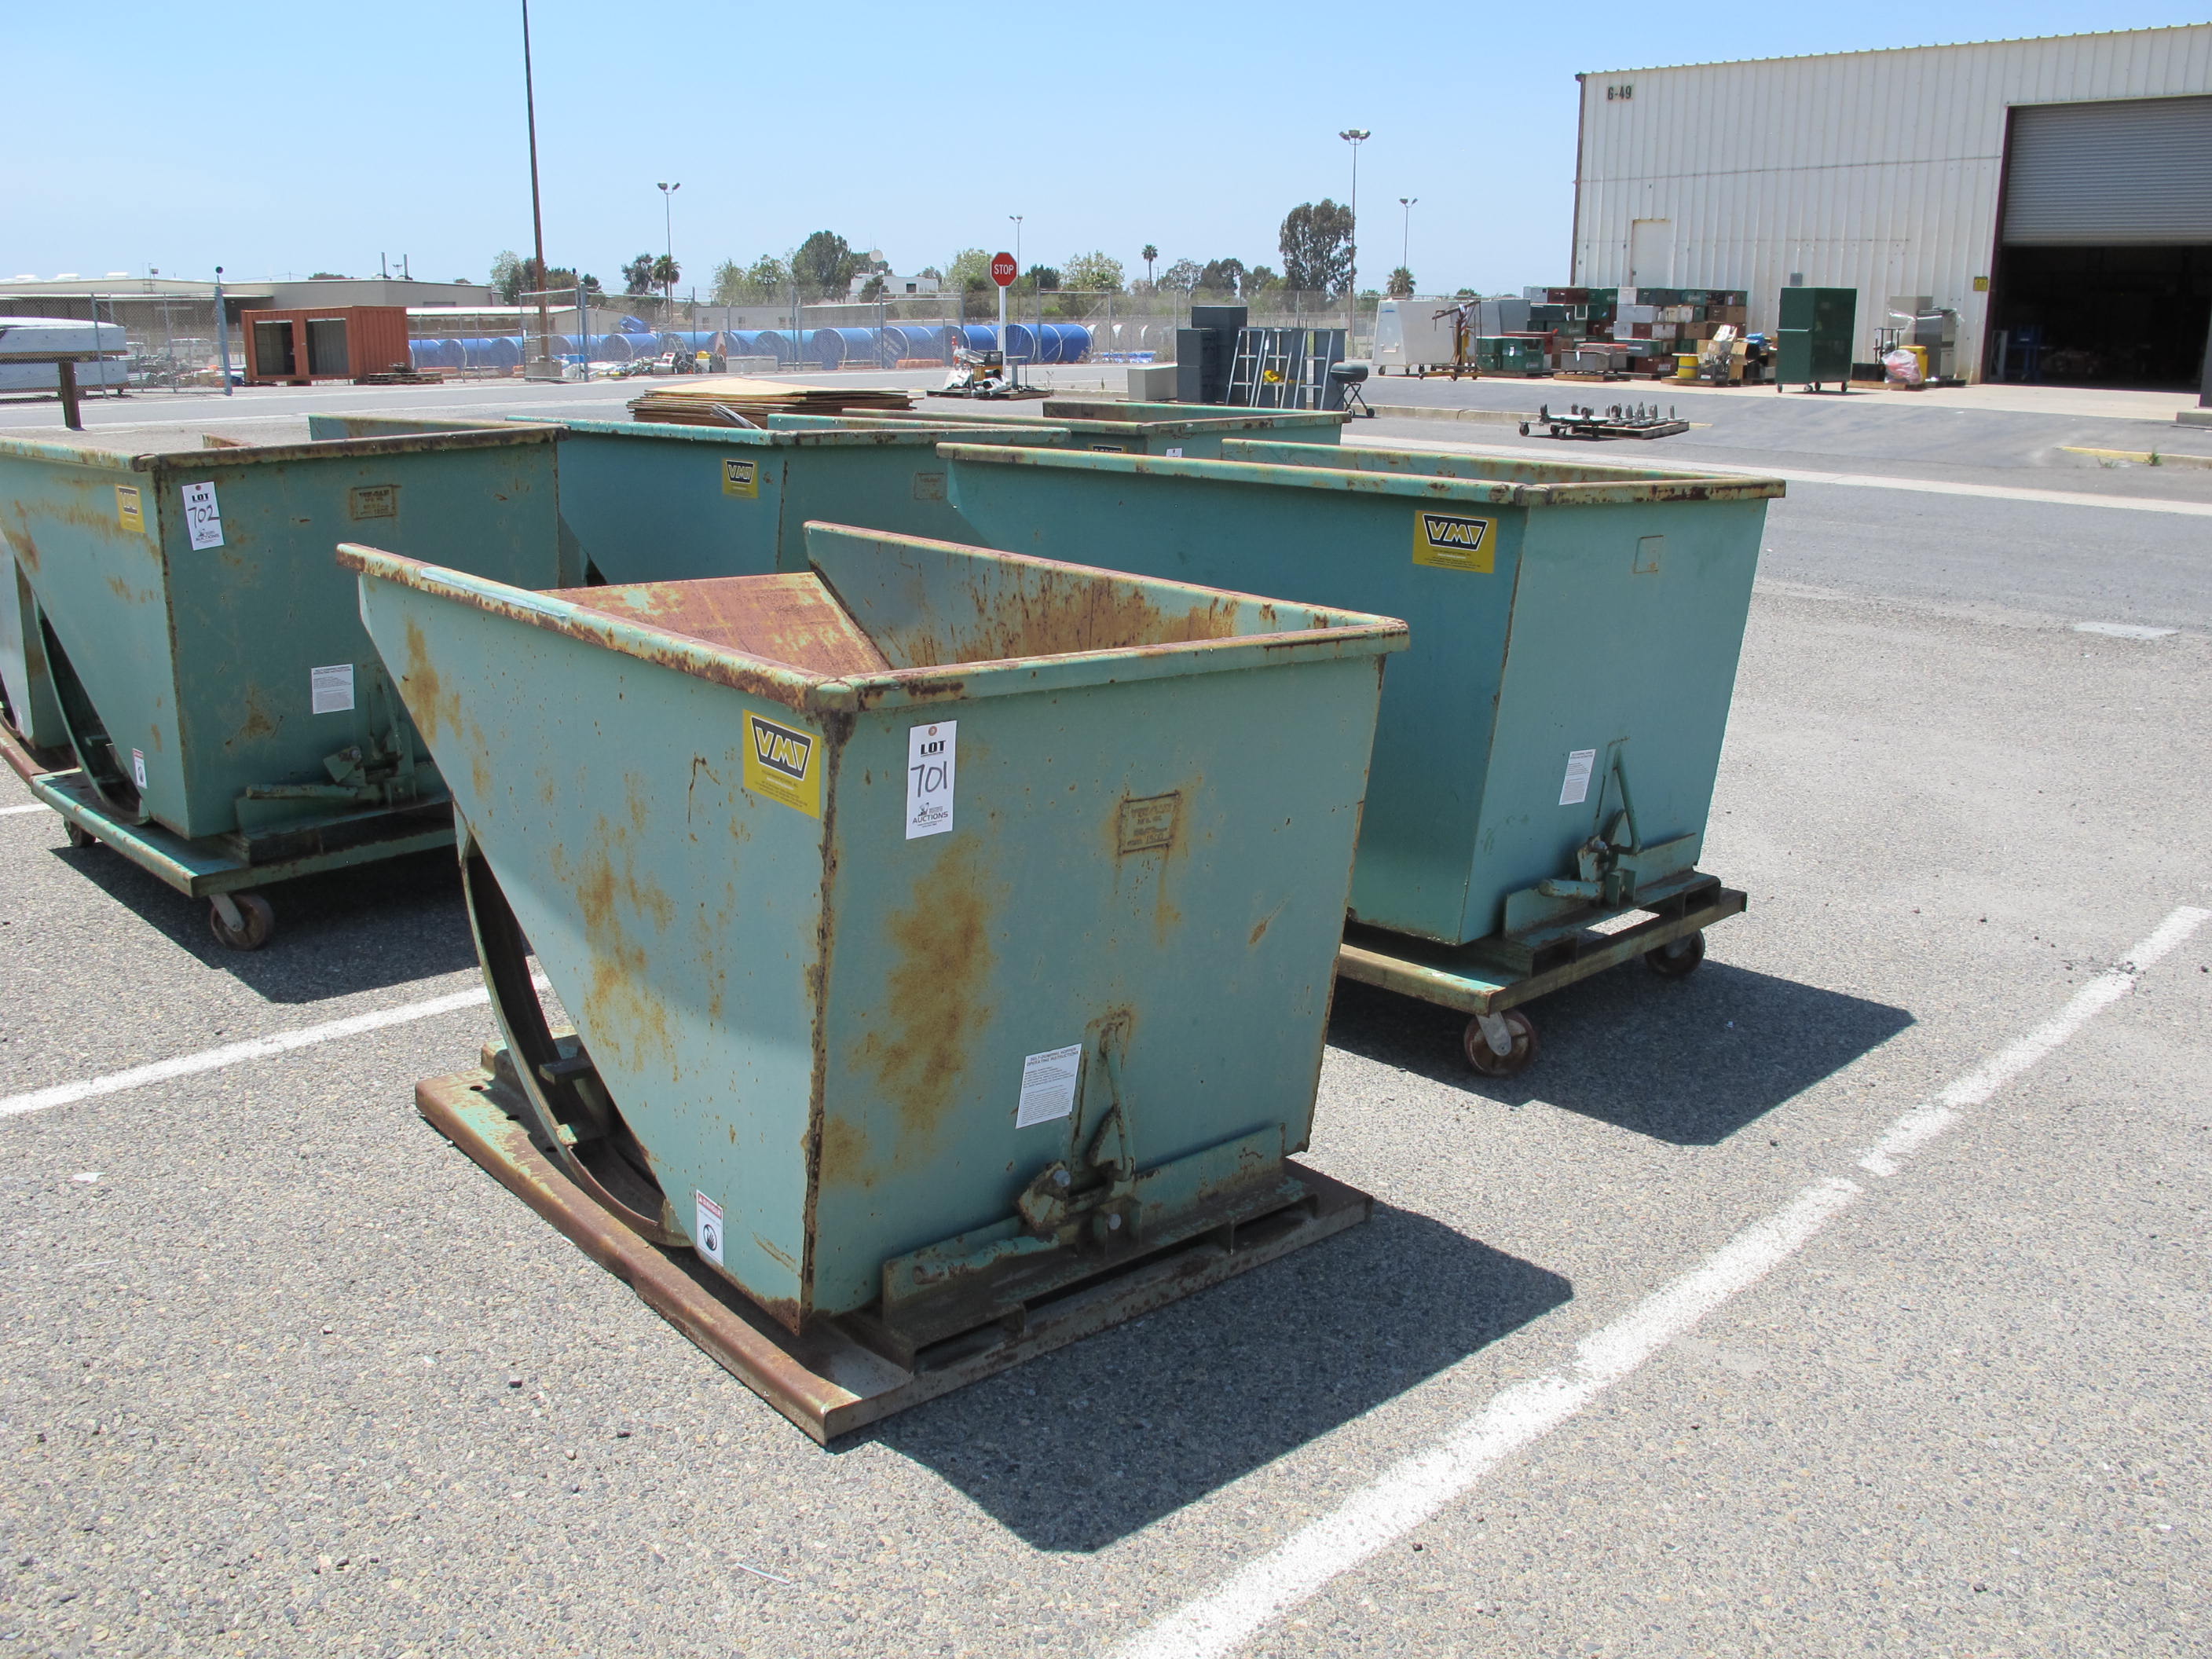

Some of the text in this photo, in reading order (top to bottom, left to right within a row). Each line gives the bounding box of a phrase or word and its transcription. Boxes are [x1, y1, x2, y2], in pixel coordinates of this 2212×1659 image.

[994, 264, 1014, 275] STOP
[191, 493, 209, 502] LOT
[188, 504, 221, 528] 702
[920, 740, 947, 756] LOT
[910, 760, 948, 797] 701
[912, 811, 949, 825] AUCTIONS
